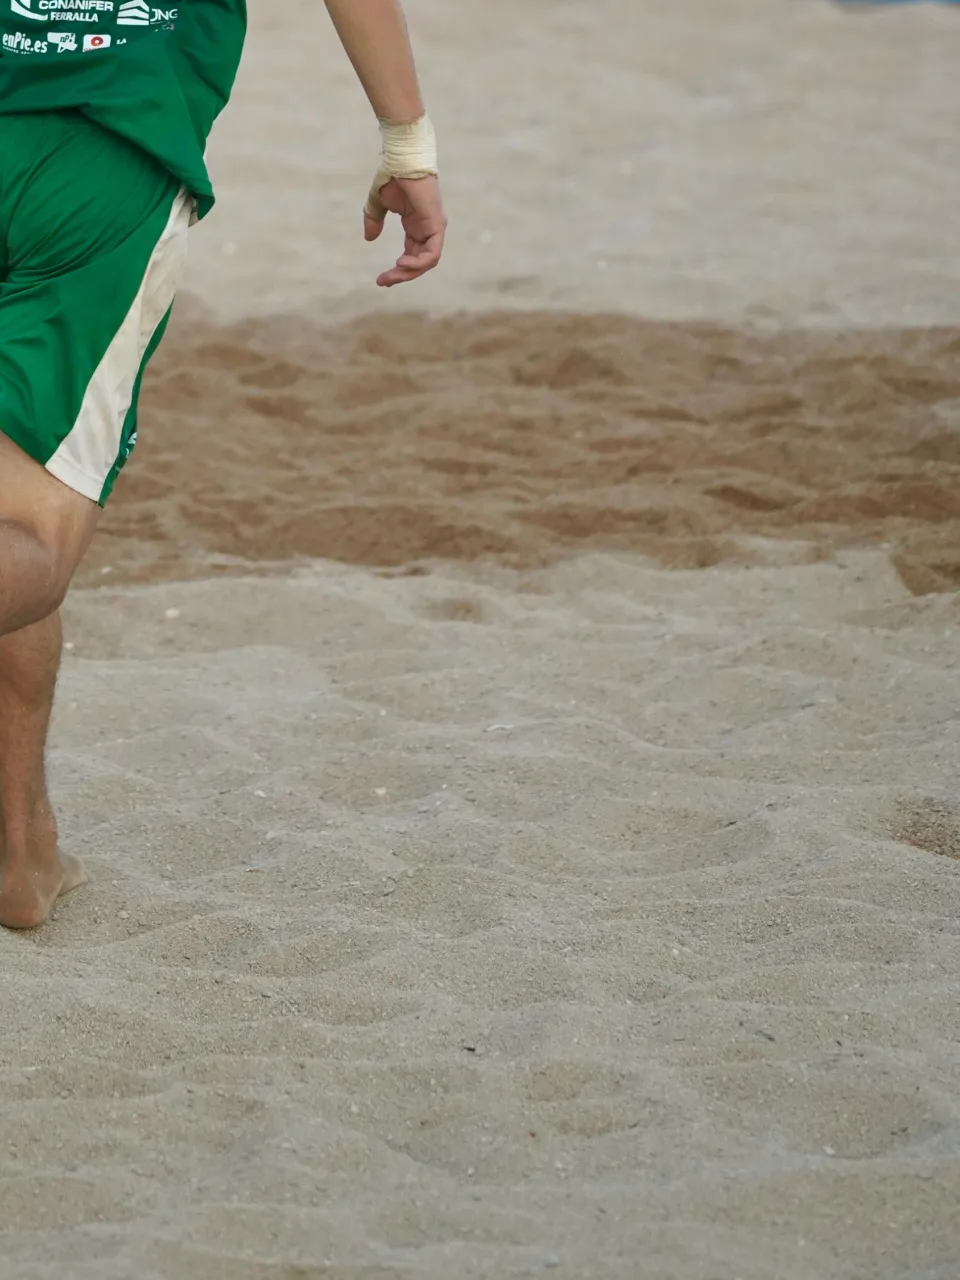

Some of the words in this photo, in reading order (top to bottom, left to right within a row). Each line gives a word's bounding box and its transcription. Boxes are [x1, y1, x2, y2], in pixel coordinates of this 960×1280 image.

[38, 0, 114, 12] CONANIFER
[50, 11, 99, 23] FERRALLA
[2, 31, 48, 54] enPie.es
